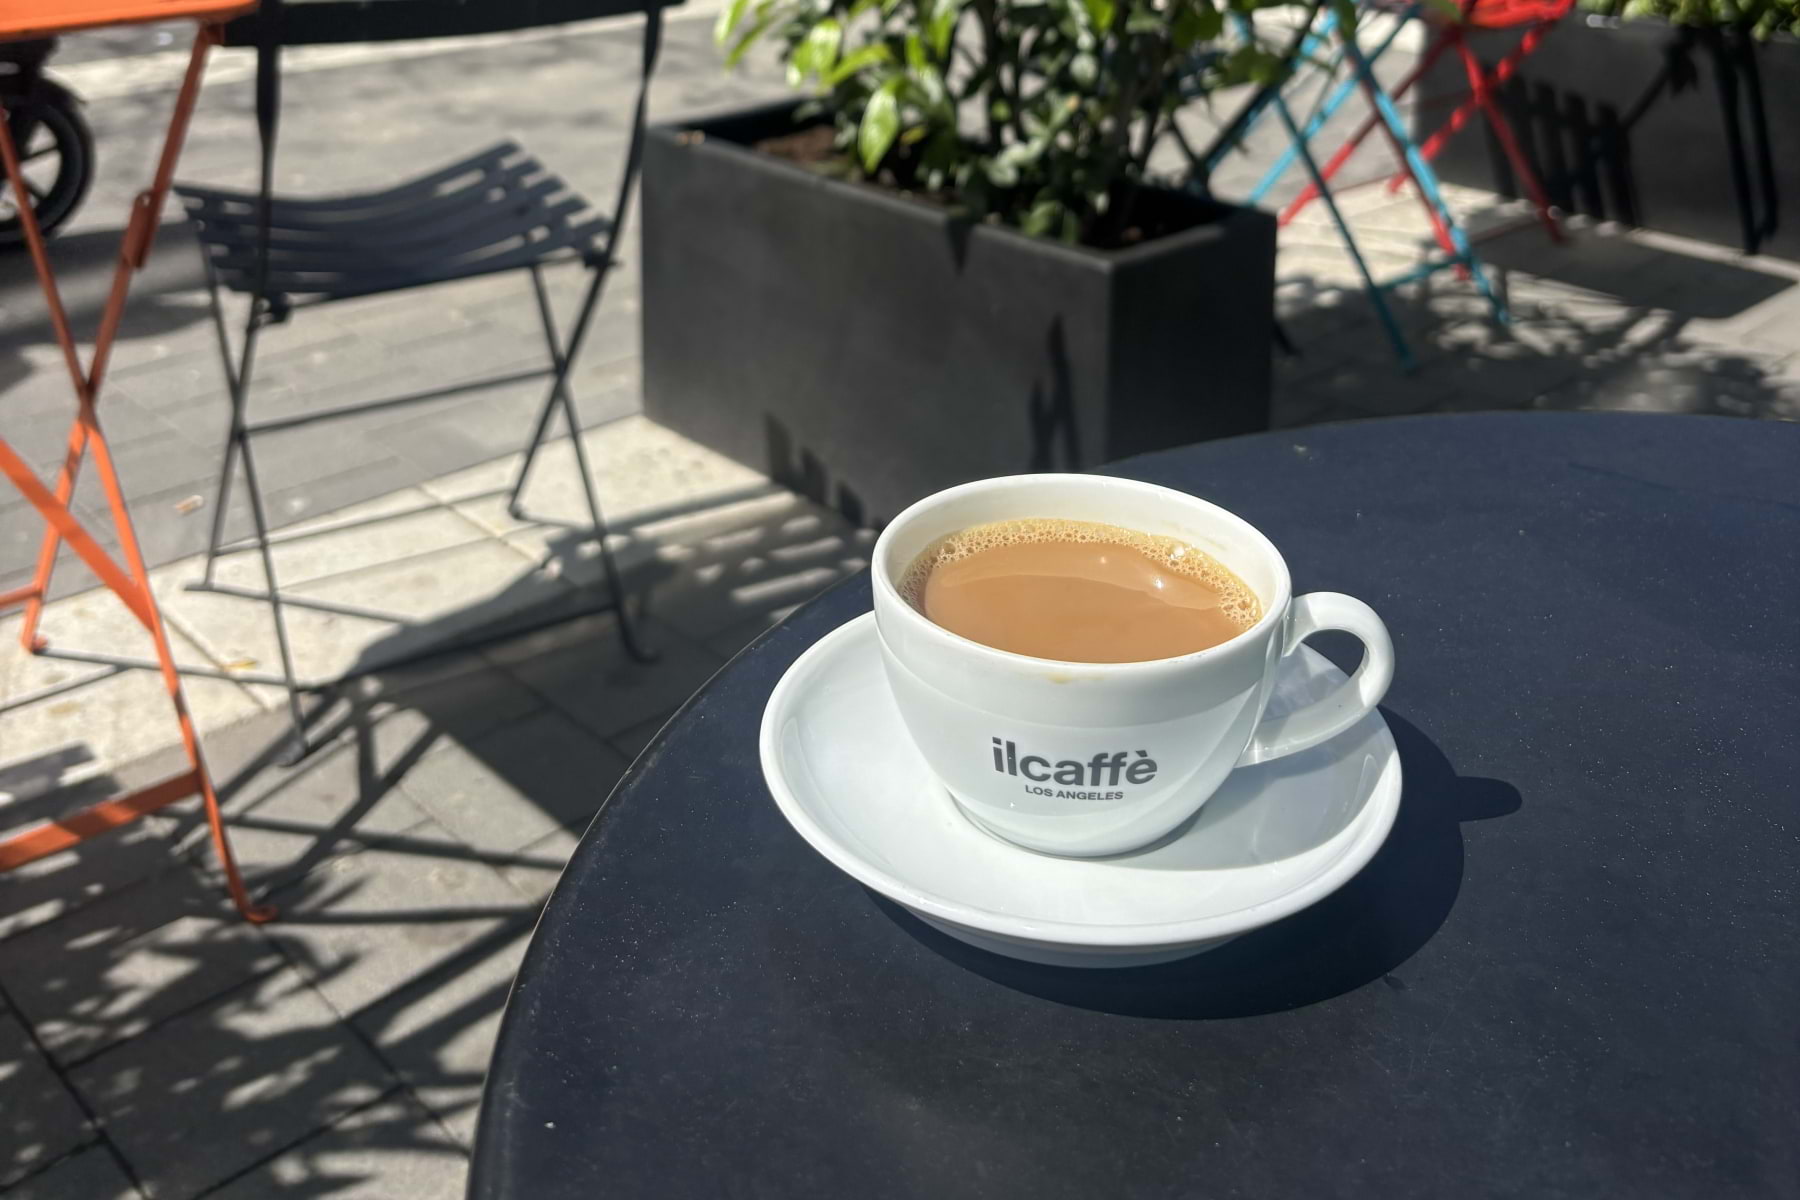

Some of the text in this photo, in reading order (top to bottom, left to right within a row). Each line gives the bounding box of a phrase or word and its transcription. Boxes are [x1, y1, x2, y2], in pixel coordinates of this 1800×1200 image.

[992, 736, 1158, 787] ilcaffè
[1025, 784, 1124, 801] LOS ANGELES
